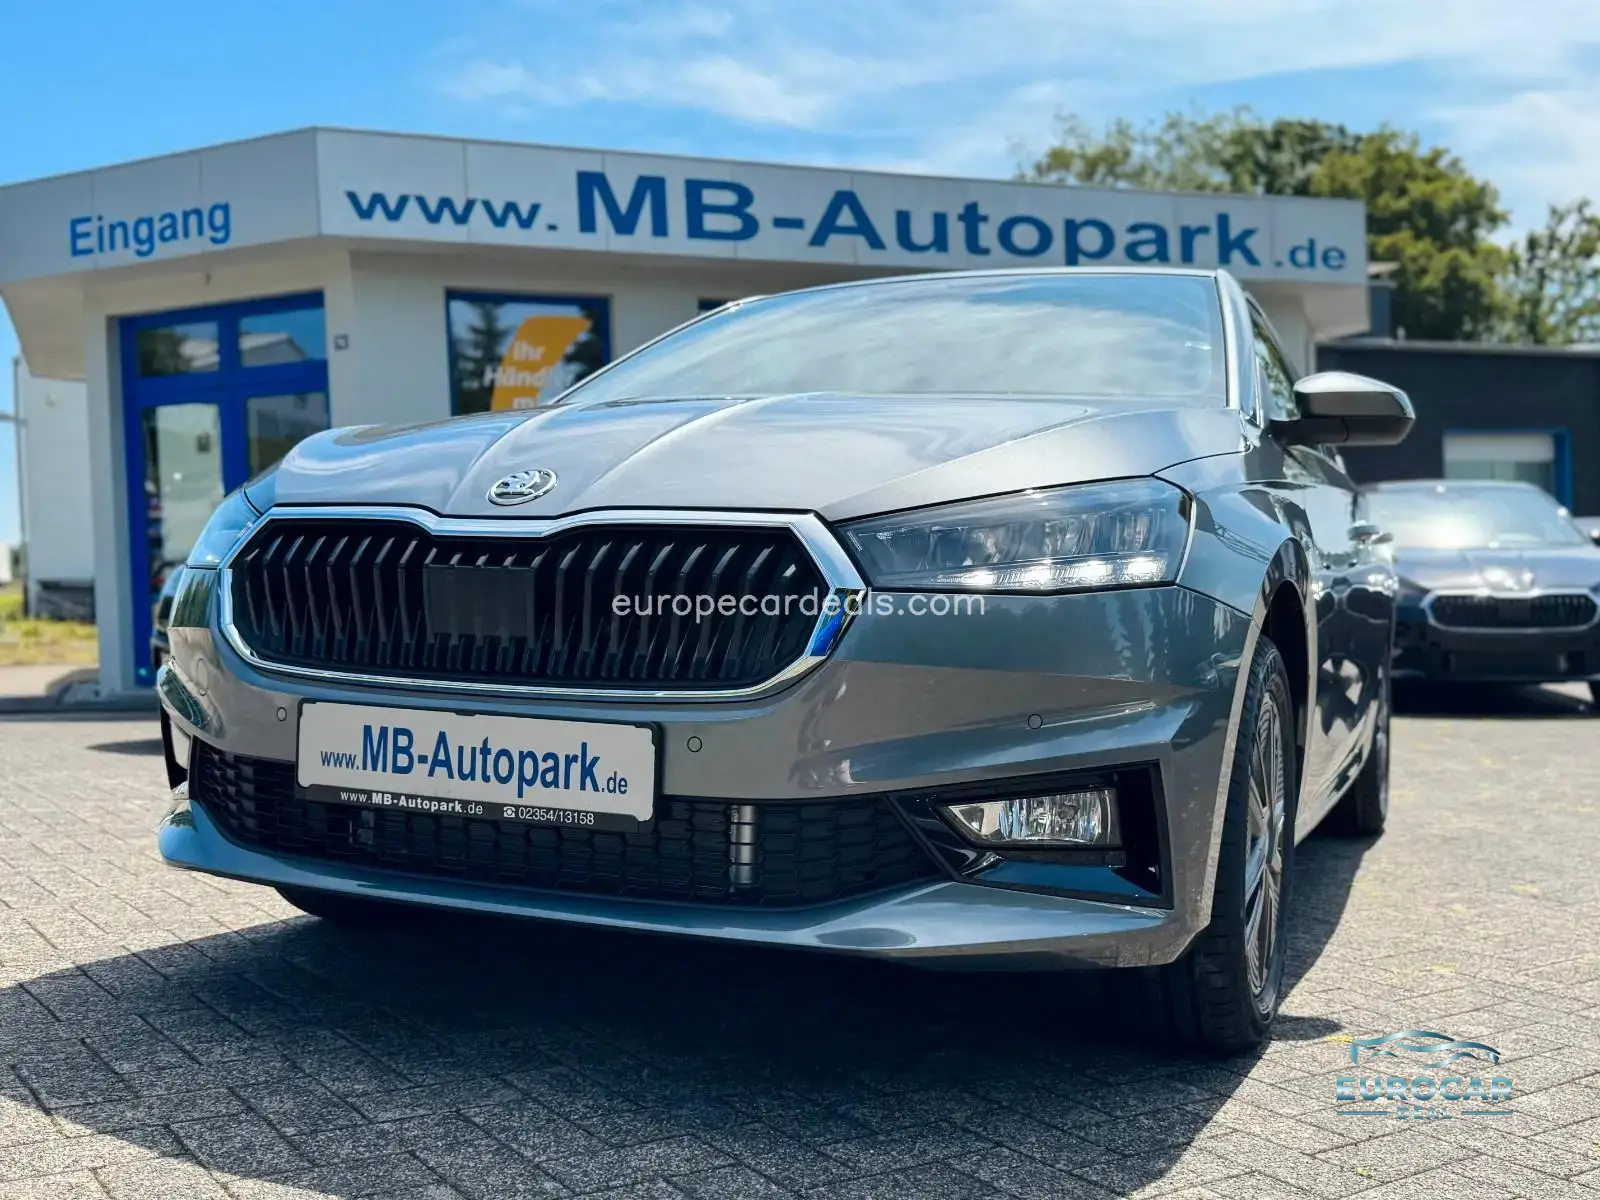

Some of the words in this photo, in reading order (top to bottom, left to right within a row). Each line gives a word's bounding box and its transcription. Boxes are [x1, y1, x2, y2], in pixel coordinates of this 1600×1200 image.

[70, 201, 231, 257] Eingang
[513, 339, 546, 361] Ihr
[320, 724, 629, 799] www.MB-Autopark.de
[340, 790, 484, 814] www.MB-Autopark.de
[518, 806, 595, 825] 02354/13158
